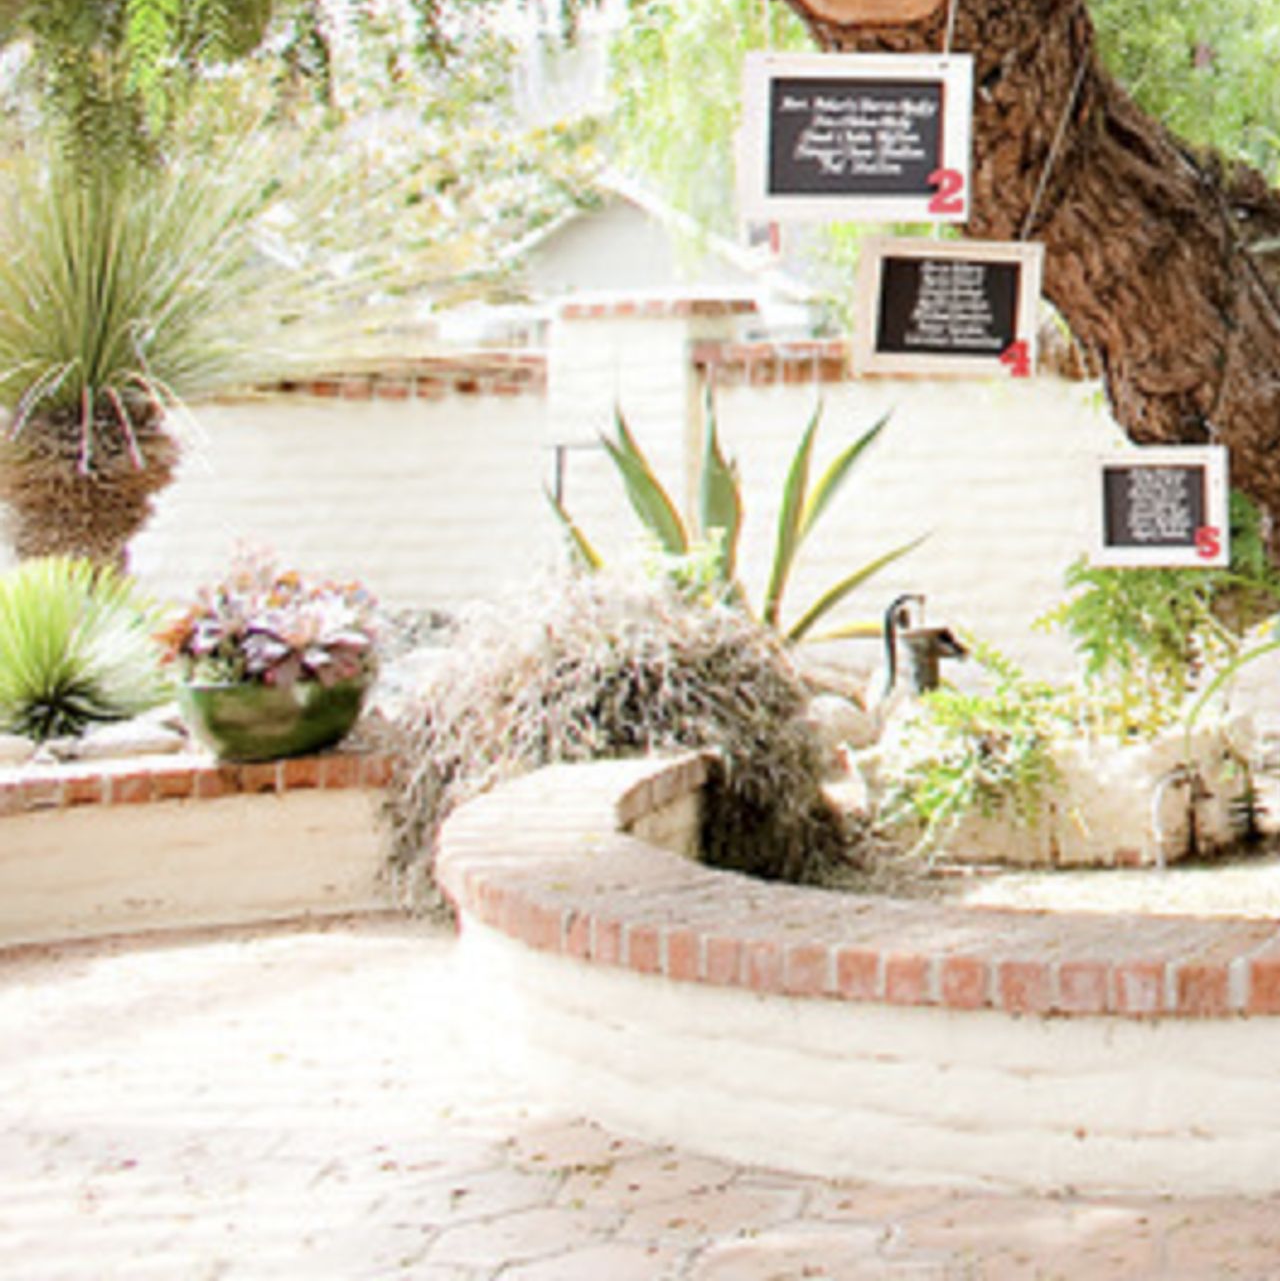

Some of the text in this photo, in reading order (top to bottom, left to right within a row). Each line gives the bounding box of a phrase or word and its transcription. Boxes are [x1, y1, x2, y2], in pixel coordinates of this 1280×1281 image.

[926, 168, 965, 214] 2
[997, 339, 1031, 378] 4
[1194, 525, 1222, 559] 5
